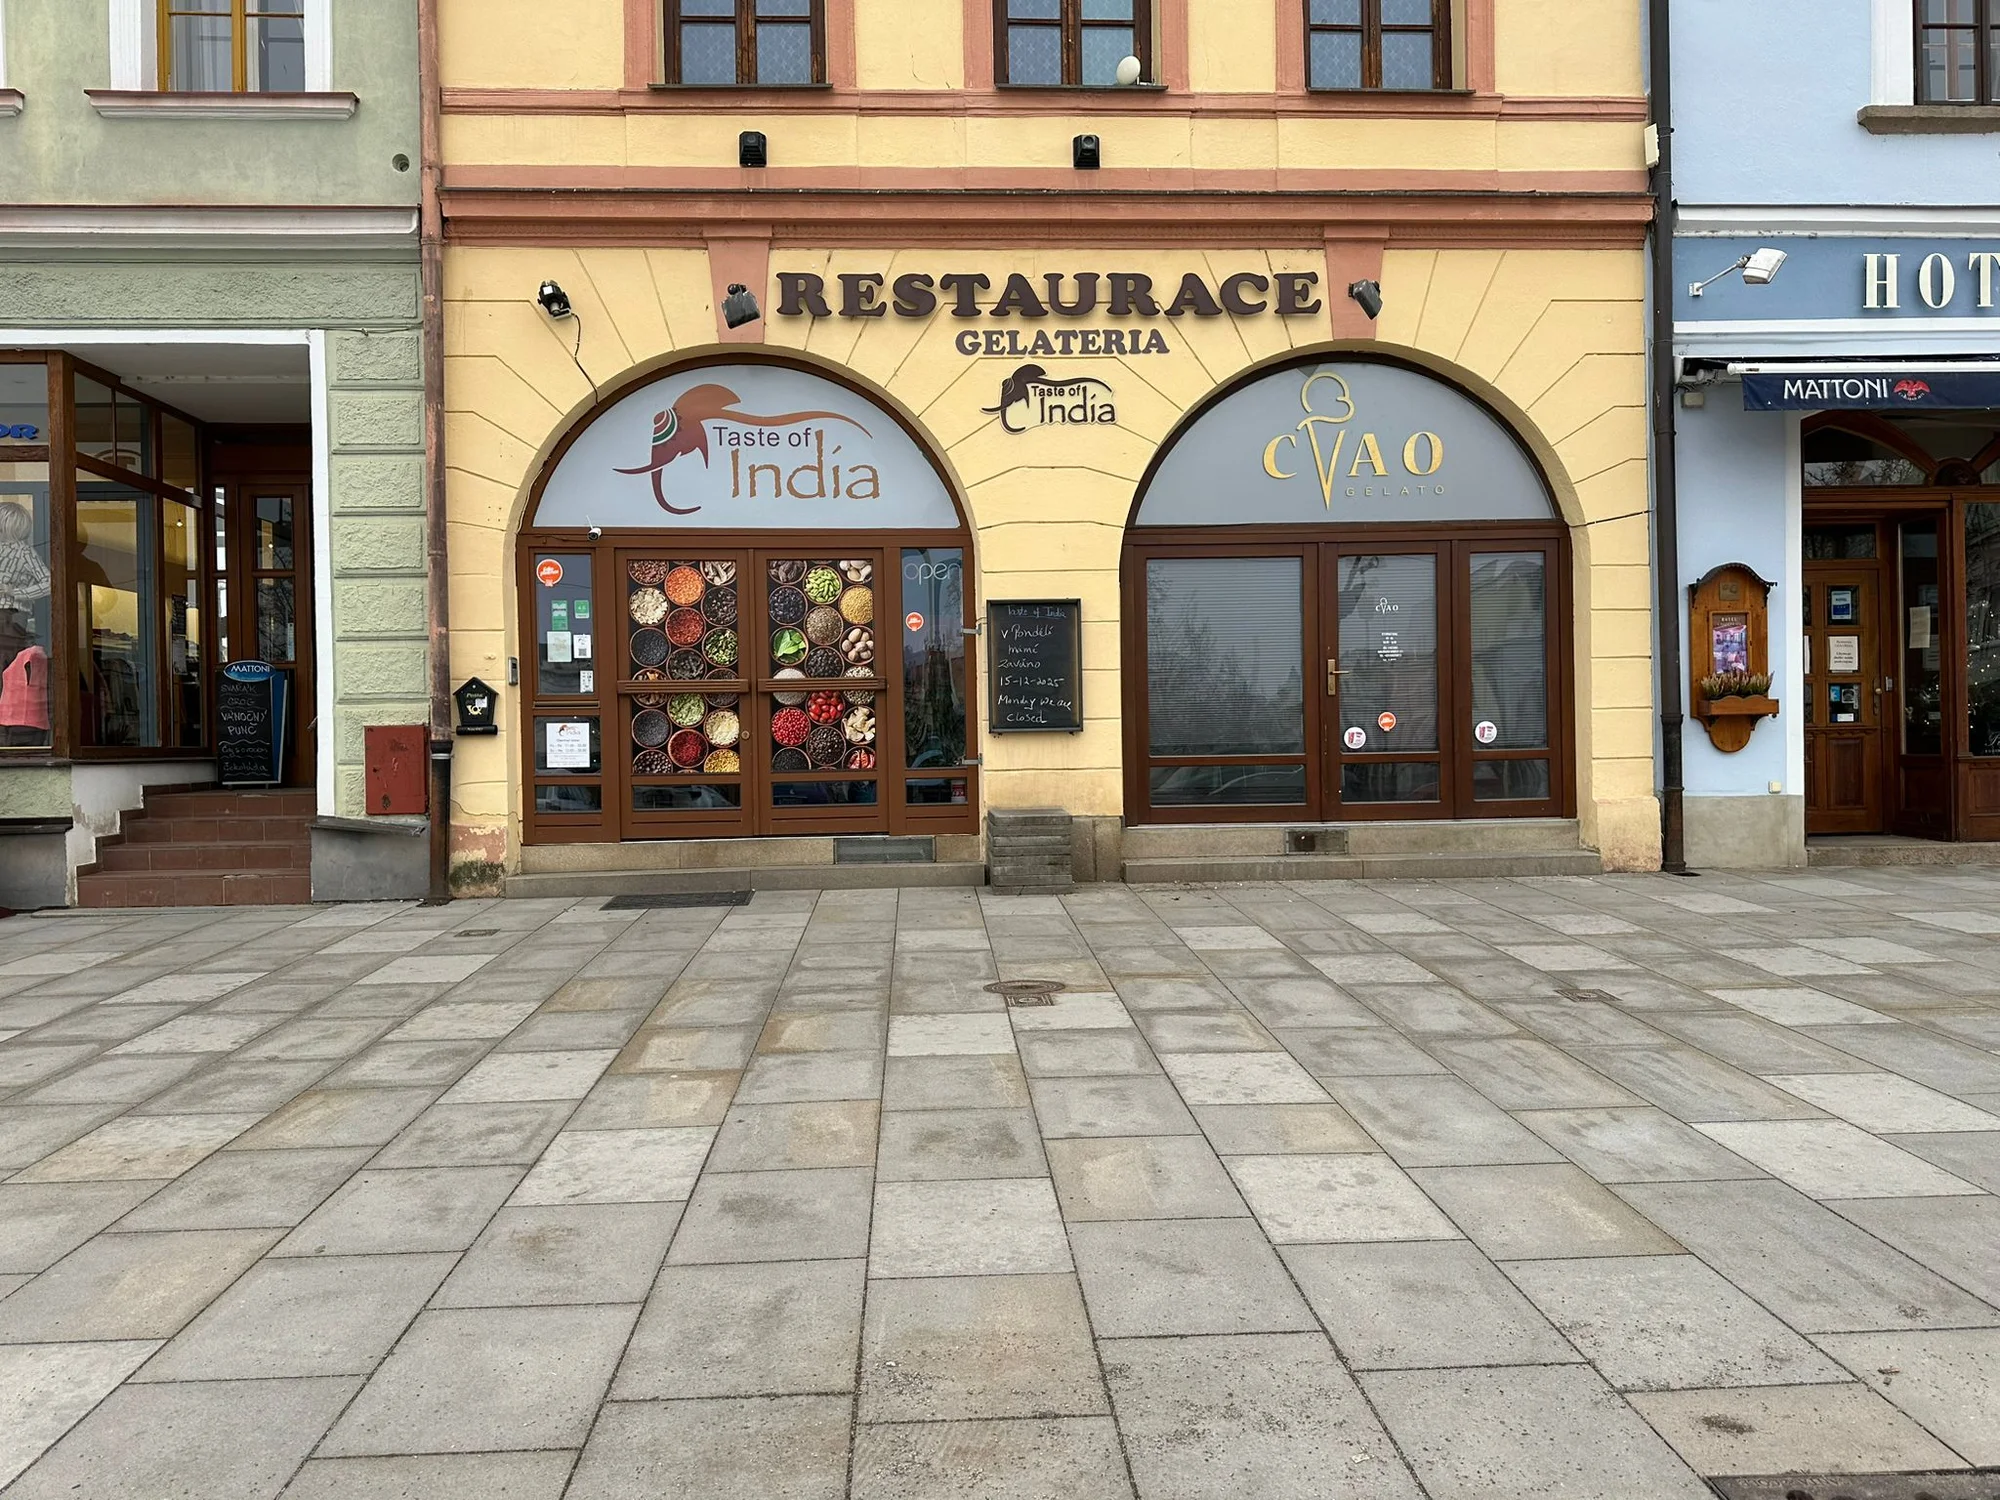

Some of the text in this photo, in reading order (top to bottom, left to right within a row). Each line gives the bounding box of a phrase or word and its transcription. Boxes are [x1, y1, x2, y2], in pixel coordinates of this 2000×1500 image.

[1863, 252, 2000, 308] HOT
[776, 271, 1322, 317] RESTAURACE
[955, 329, 1170, 355] GELATERIA
[1031, 384, 1081, 397] Taste of
[1783, 378, 1889, 400] MATTONI
[712, 426, 812, 447] Taste of
[1346, 485, 1445, 497] GELATO
[904, 563, 961, 585] open
[230, 665, 270, 673] MATTONI
[1000, 676, 1065, 687] 15-12-2025
[227, 721, 258, 736] PUNČ
